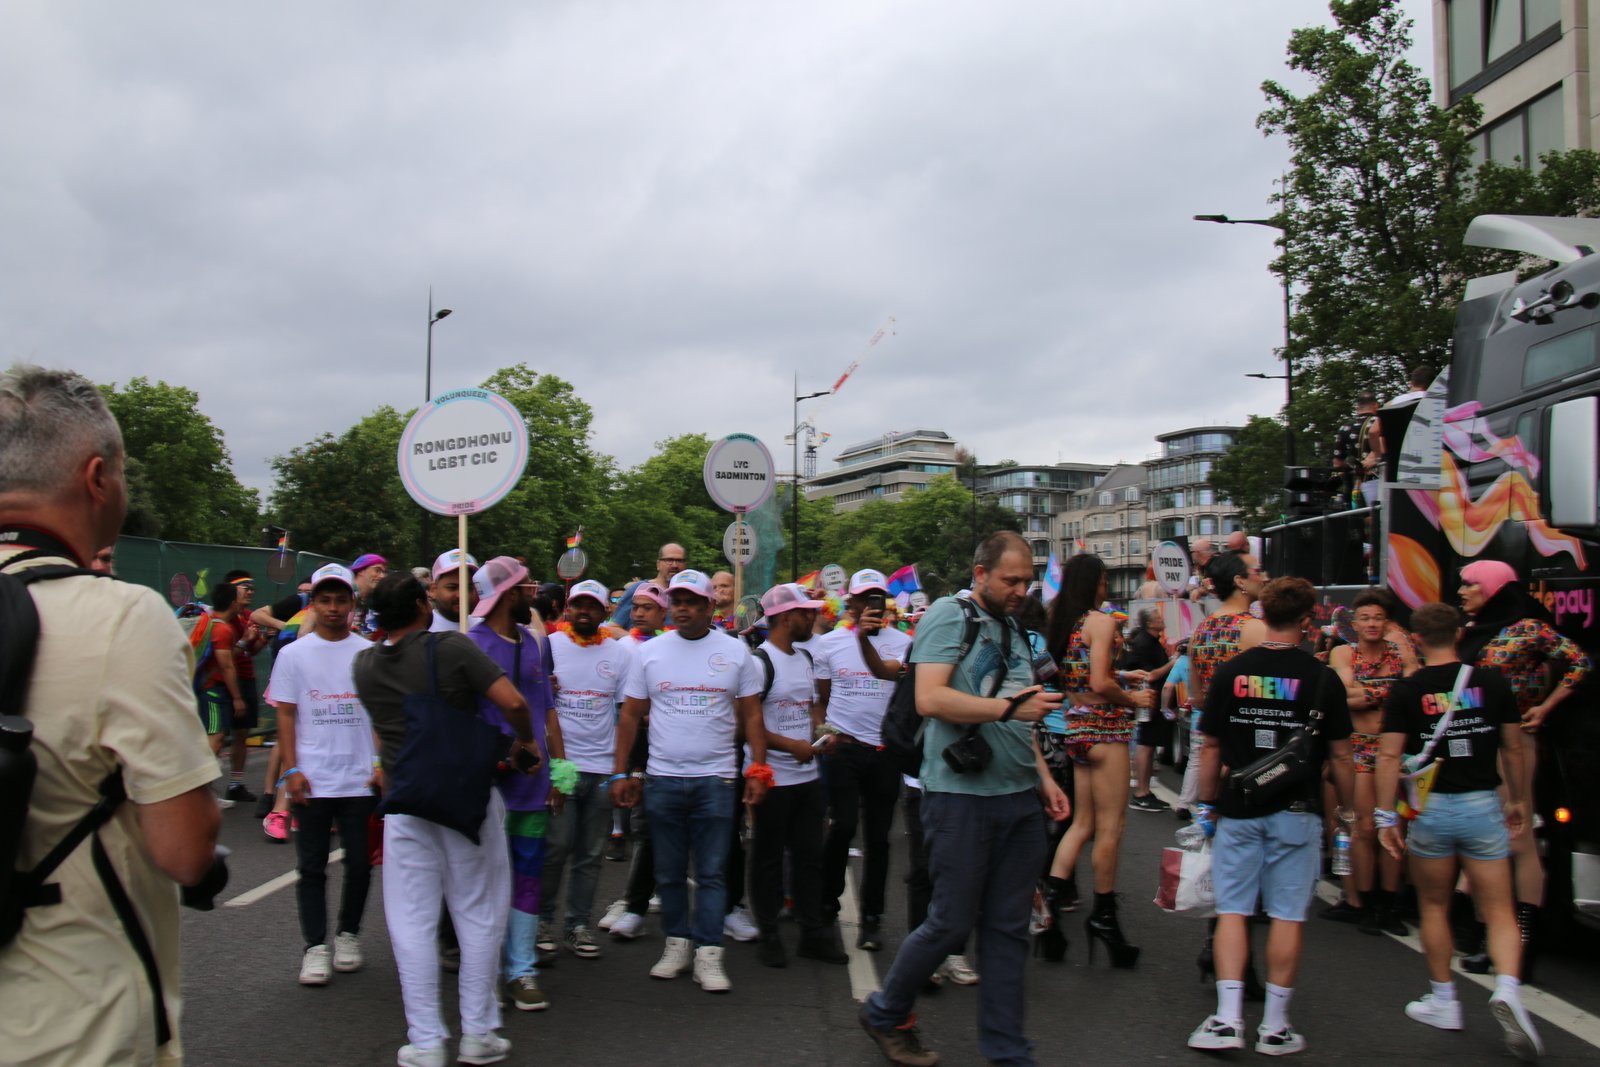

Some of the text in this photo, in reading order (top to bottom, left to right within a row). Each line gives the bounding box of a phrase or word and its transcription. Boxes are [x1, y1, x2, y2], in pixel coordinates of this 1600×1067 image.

[413, 431, 512, 455] RONGDHONU
[428, 451, 498, 471] LGBT CIC
[733, 460, 749, 469] LYC
[715, 471, 766, 481] BADMINTON
[1159, 557, 1183, 568] PRIDE
[1165, 571, 1181, 581] PAY
[1233, 675, 1301, 701] CREW
[1239, 707, 1294, 717] GLOBESTAR
[1430, 717, 1482, 730] GBESTAR
